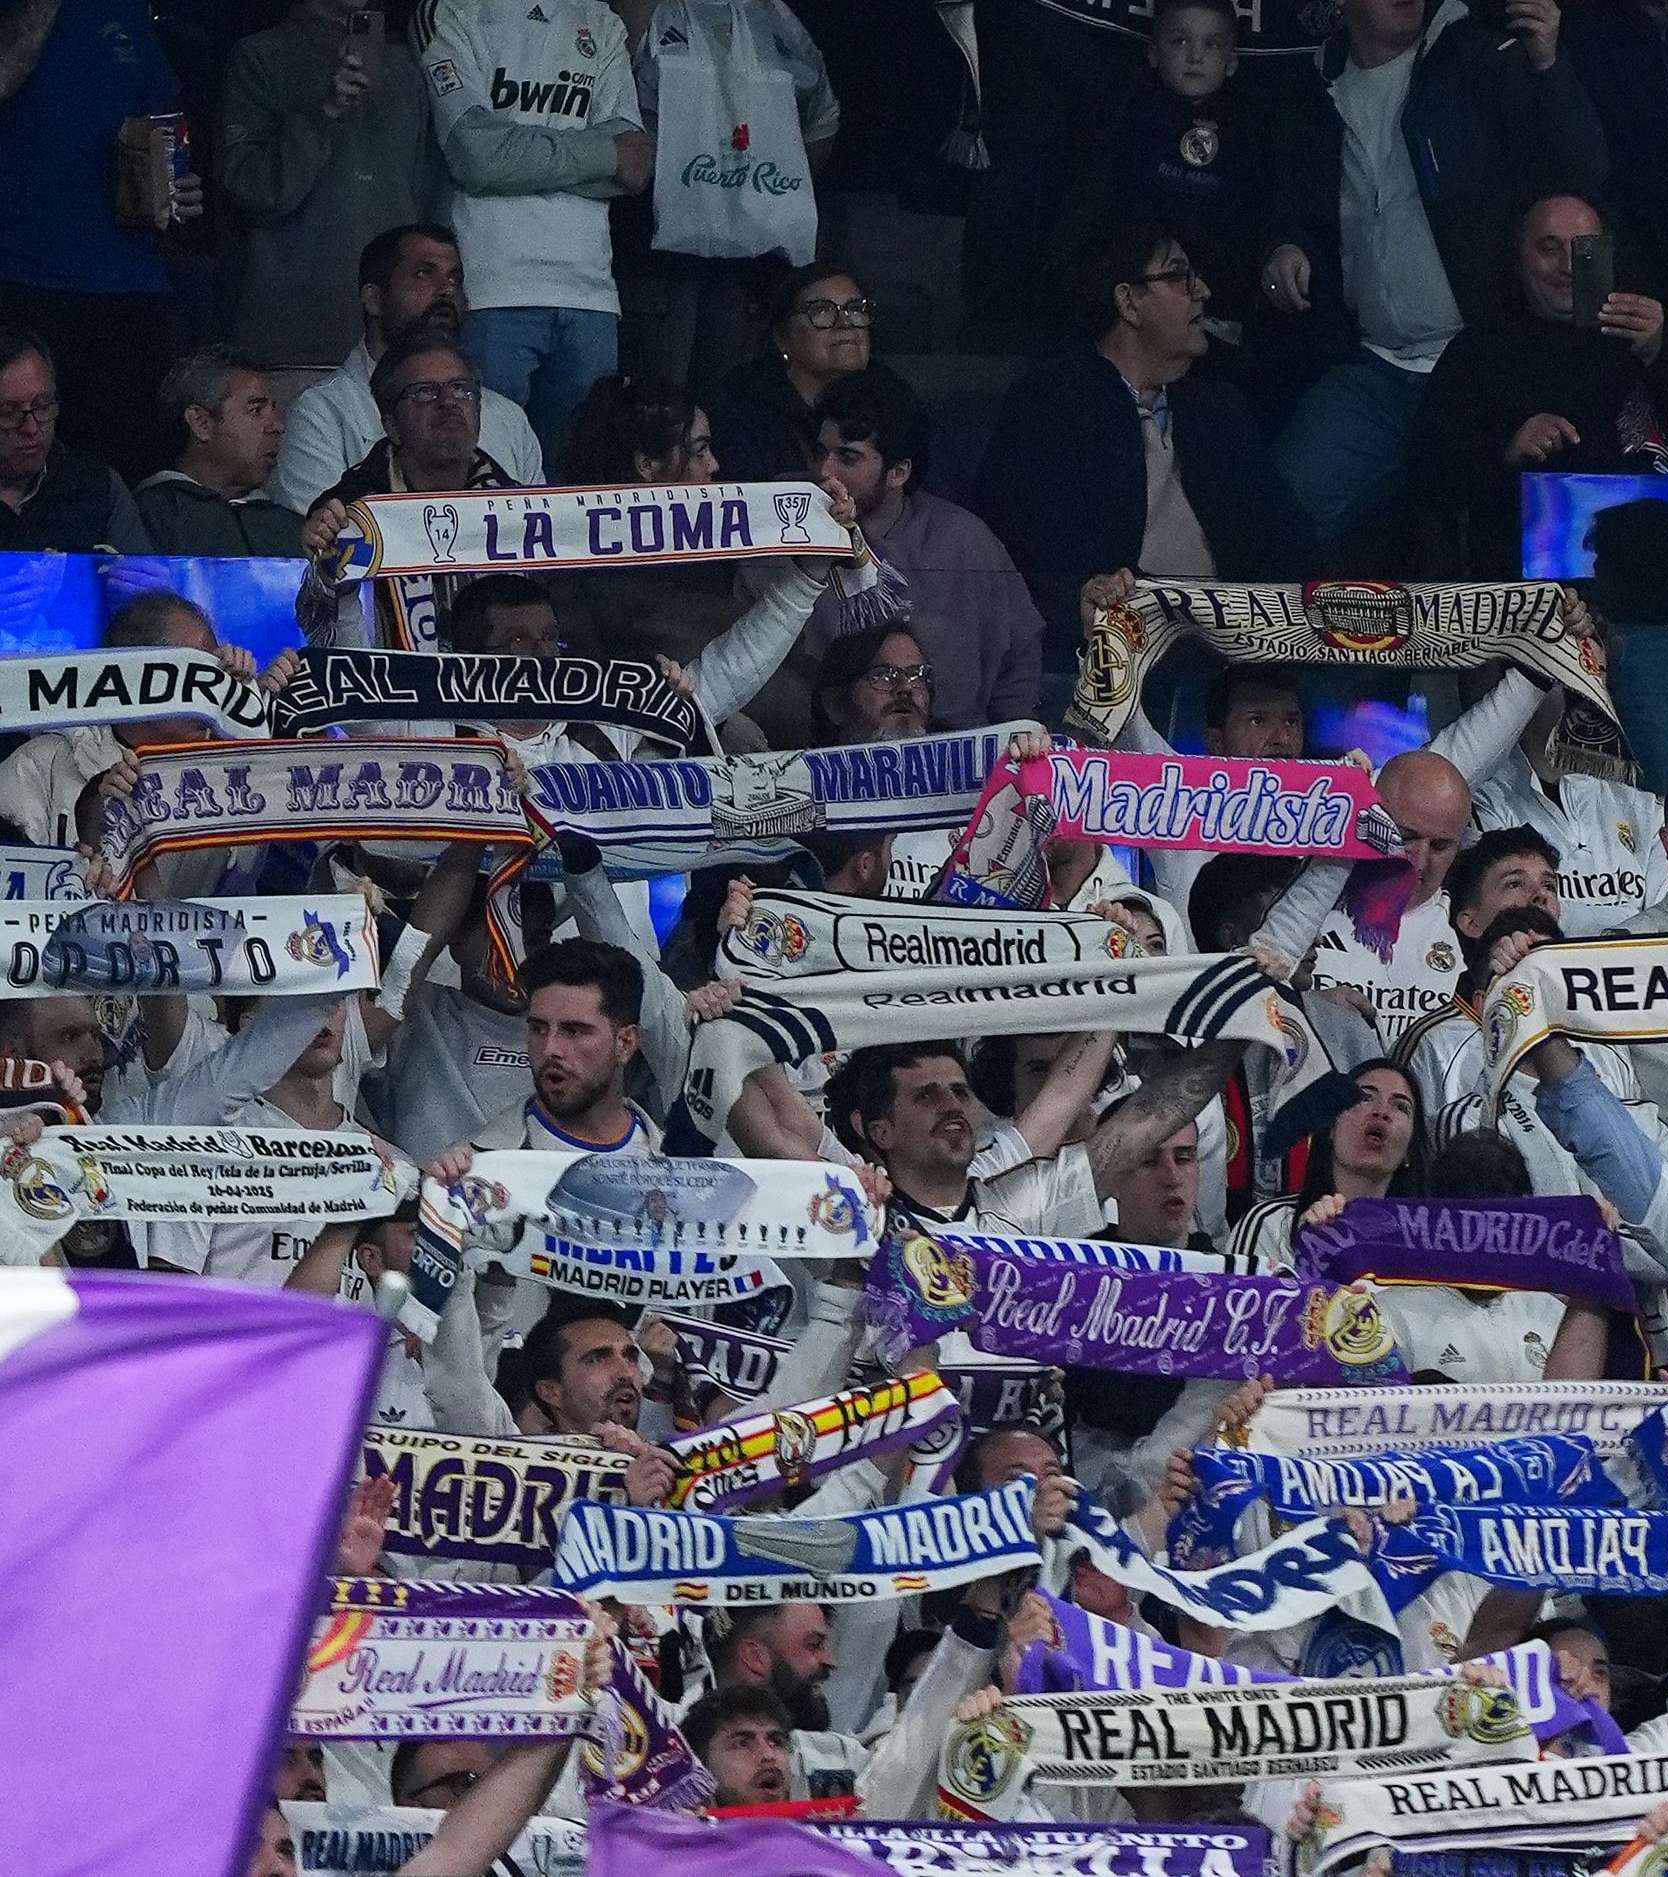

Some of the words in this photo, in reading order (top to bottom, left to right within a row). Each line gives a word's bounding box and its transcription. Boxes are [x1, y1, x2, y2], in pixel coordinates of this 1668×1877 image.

[489, 67, 592, 119] bwin
[680, 153, 751, 190] Puerto
[751, 161, 803, 196] Rico
[576, 485, 745, 507] MADRIDISTA
[784, 495, 802, 510] 35
[434, 528, 451, 542] 14
[484, 511, 557, 561] LA
[586, 499, 755, 557] COMA
[1149, 585, 1306, 629] REAL
[1414, 583, 1571, 644] MADRID
[1232, 632, 1309, 660] ESTADIO
[1314, 642, 1401, 665] SANTIAGO
[1403, 637, 1482, 663] BERNABEU
[28, 660, 267, 729] MADRID
[437, 655, 697, 742] MADRID
[286, 760, 523, 817] MADRI
[530, 760, 714, 814] JUANITO
[1050, 753, 1354, 850] Madridista
[28, 911, 89, 934] PEÑA
[100, 909, 247, 933] MADRIDISTA
[7, 936, 278, 989] OPORTO
[864, 921, 1047, 967] Realmadrid
[863, 974, 1138, 1011] Realmadrid
[58, 1133, 124, 1155] Real
[132, 1132, 227, 1155] Madrid
[100, 1161, 133, 1176] Final
[135, 1163, 166, 1179] Copa
[168, 1162, 189, 1178] del
[242, 1162, 260, 1178] de
[190, 1199, 204, 1215] de
[241, 1198, 306, 1215] Comunidad
[308, 1199, 321, 1213] de
[323, 1197, 367, 1213] Madrid
[1397, 1203, 1548, 1258] MADRID
[548, 1259, 645, 1297] MADRID
[646, 1271, 734, 1300] PLAYER
[978, 1261, 1078, 1341] Real
[1070, 1274, 1216, 1355] Madrid
[1306, 1403, 1420, 1439] REAL
[1429, 1400, 1595, 1436] MADRID
[471, 1442, 530, 1460] DEL
[557, 1503, 727, 1584] MADRID
[861, 1475, 1040, 1567] MADRID
[725, 1580, 776, 1602] DEL
[780, 1579, 878, 1602] MUNDO
[336, 1646, 420, 1695] Real
[422, 1646, 546, 1697] Madrid
[1057, 1708, 1190, 1762] REAL
[1204, 1695, 1408, 1760] MADRID
[1131, 1763, 1188, 1781] ESTADIO
[1191, 1761, 1260, 1778] SANTIAGO
[1383, 1776, 1500, 1817] REAL
[302, 1830, 357, 1871] REAL
